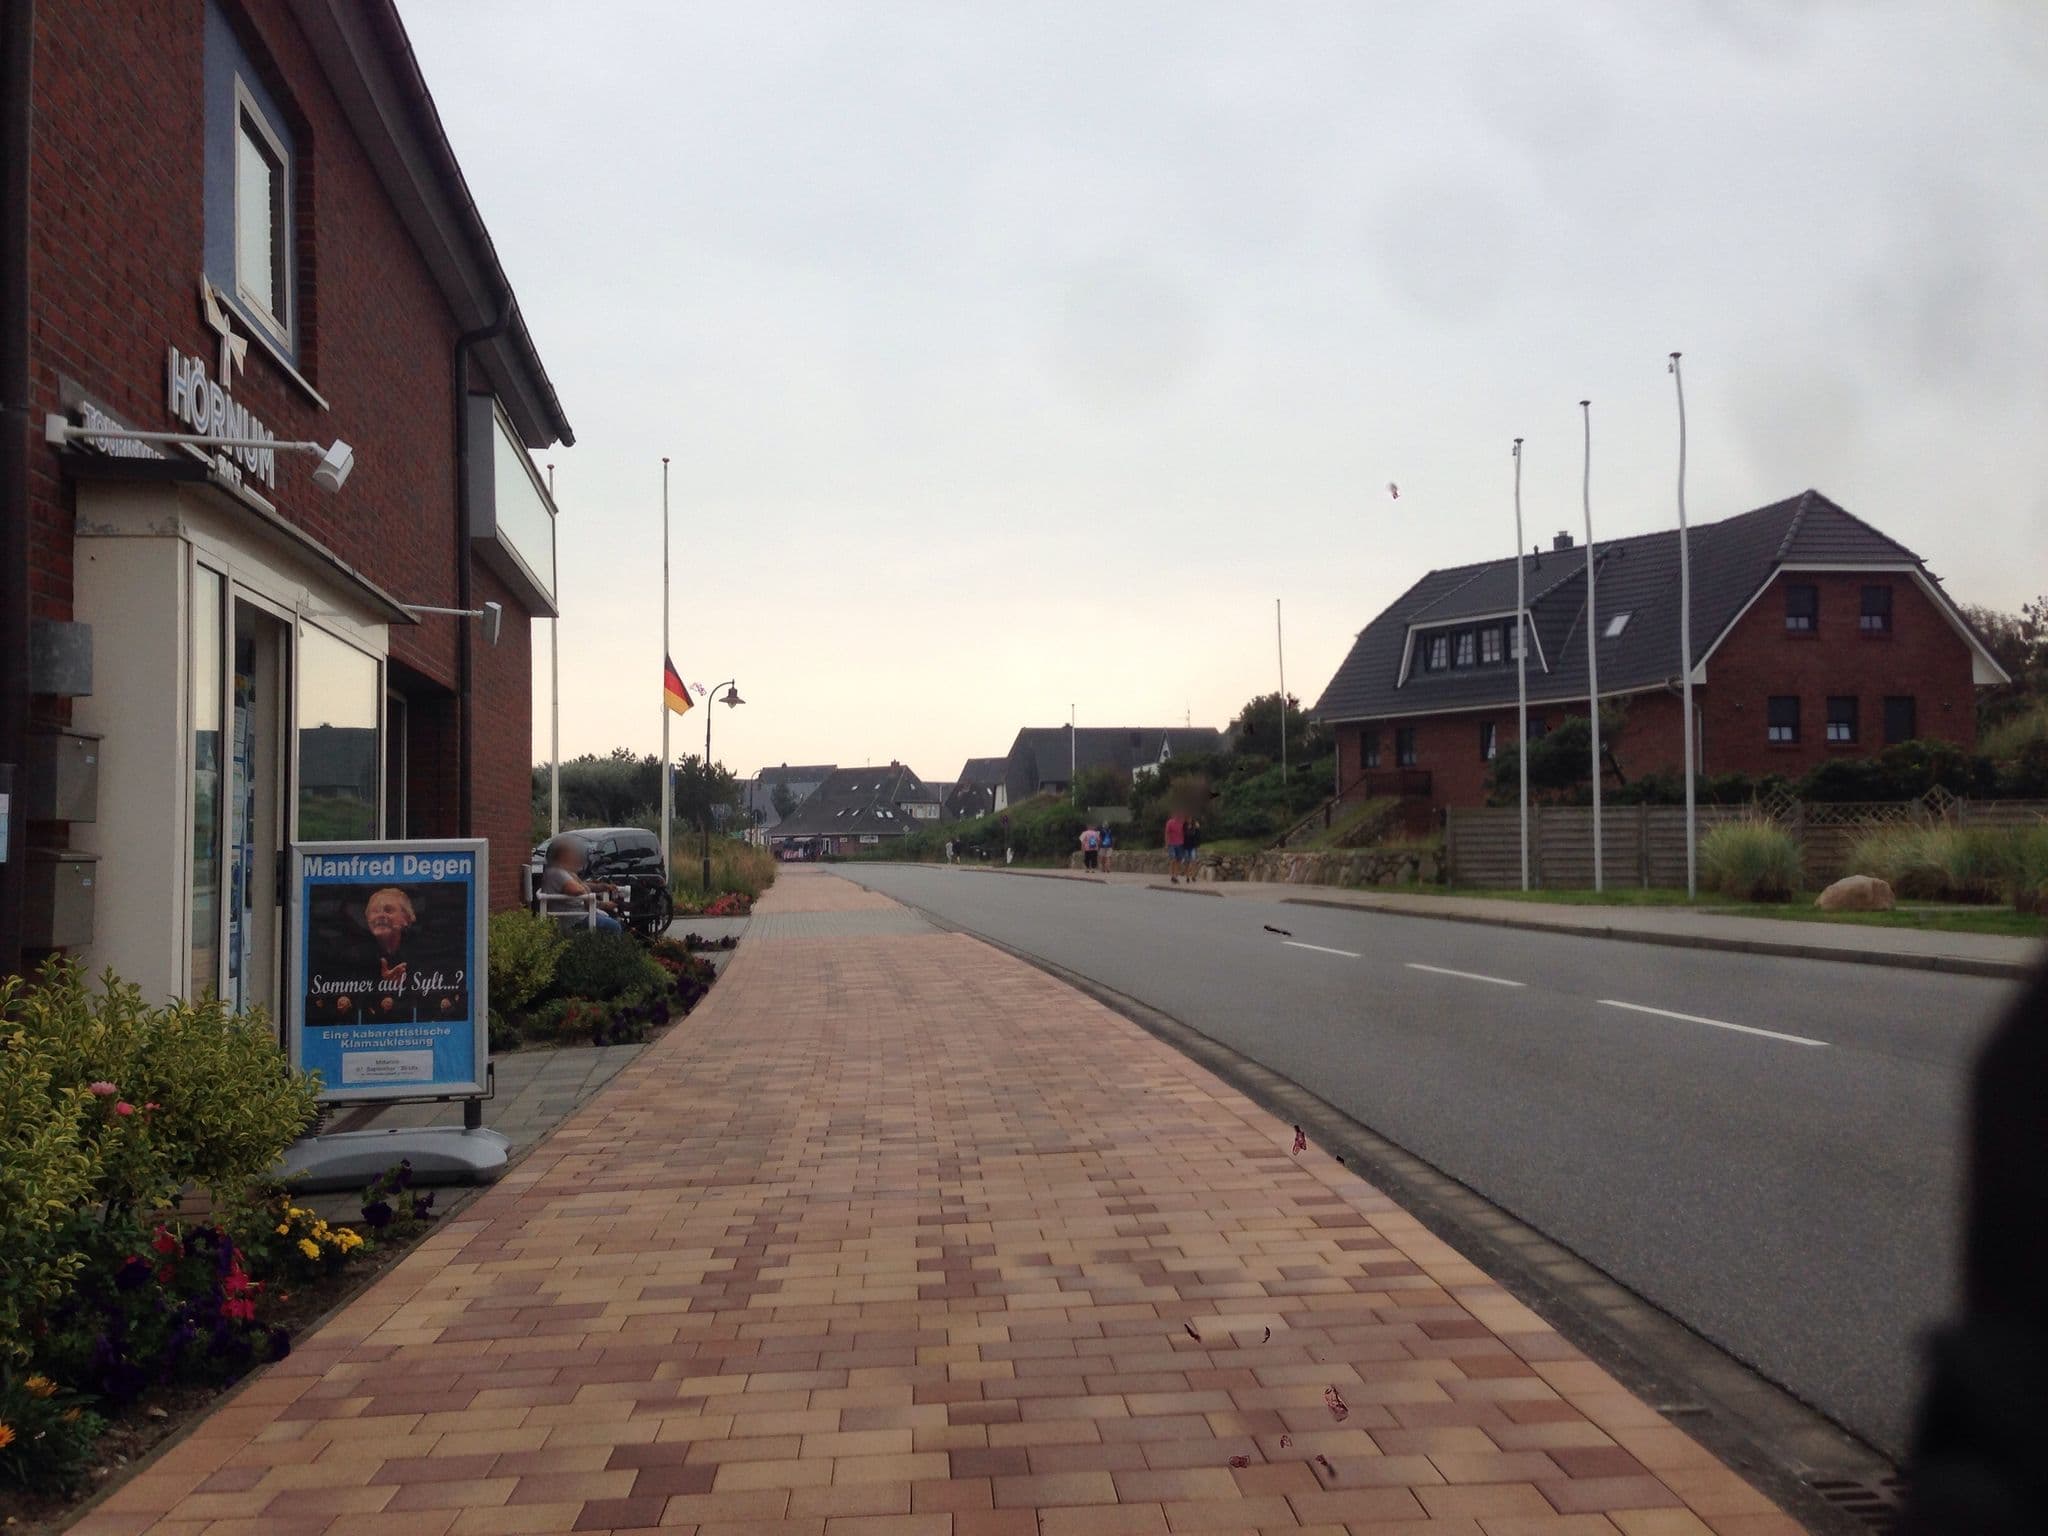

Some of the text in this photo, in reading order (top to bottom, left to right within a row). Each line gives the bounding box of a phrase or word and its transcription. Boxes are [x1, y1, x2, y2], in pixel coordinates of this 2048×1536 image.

[169, 346, 275, 490] HÖRNUM
[304, 855, 472, 880] Manfred Degen
[311, 974, 374, 994] Sommer
[378, 972, 407, 997] auf
[322, 1026, 451, 1040] Eine kabarettistische
[340, 1037, 433, 1049] Klamauklesung
